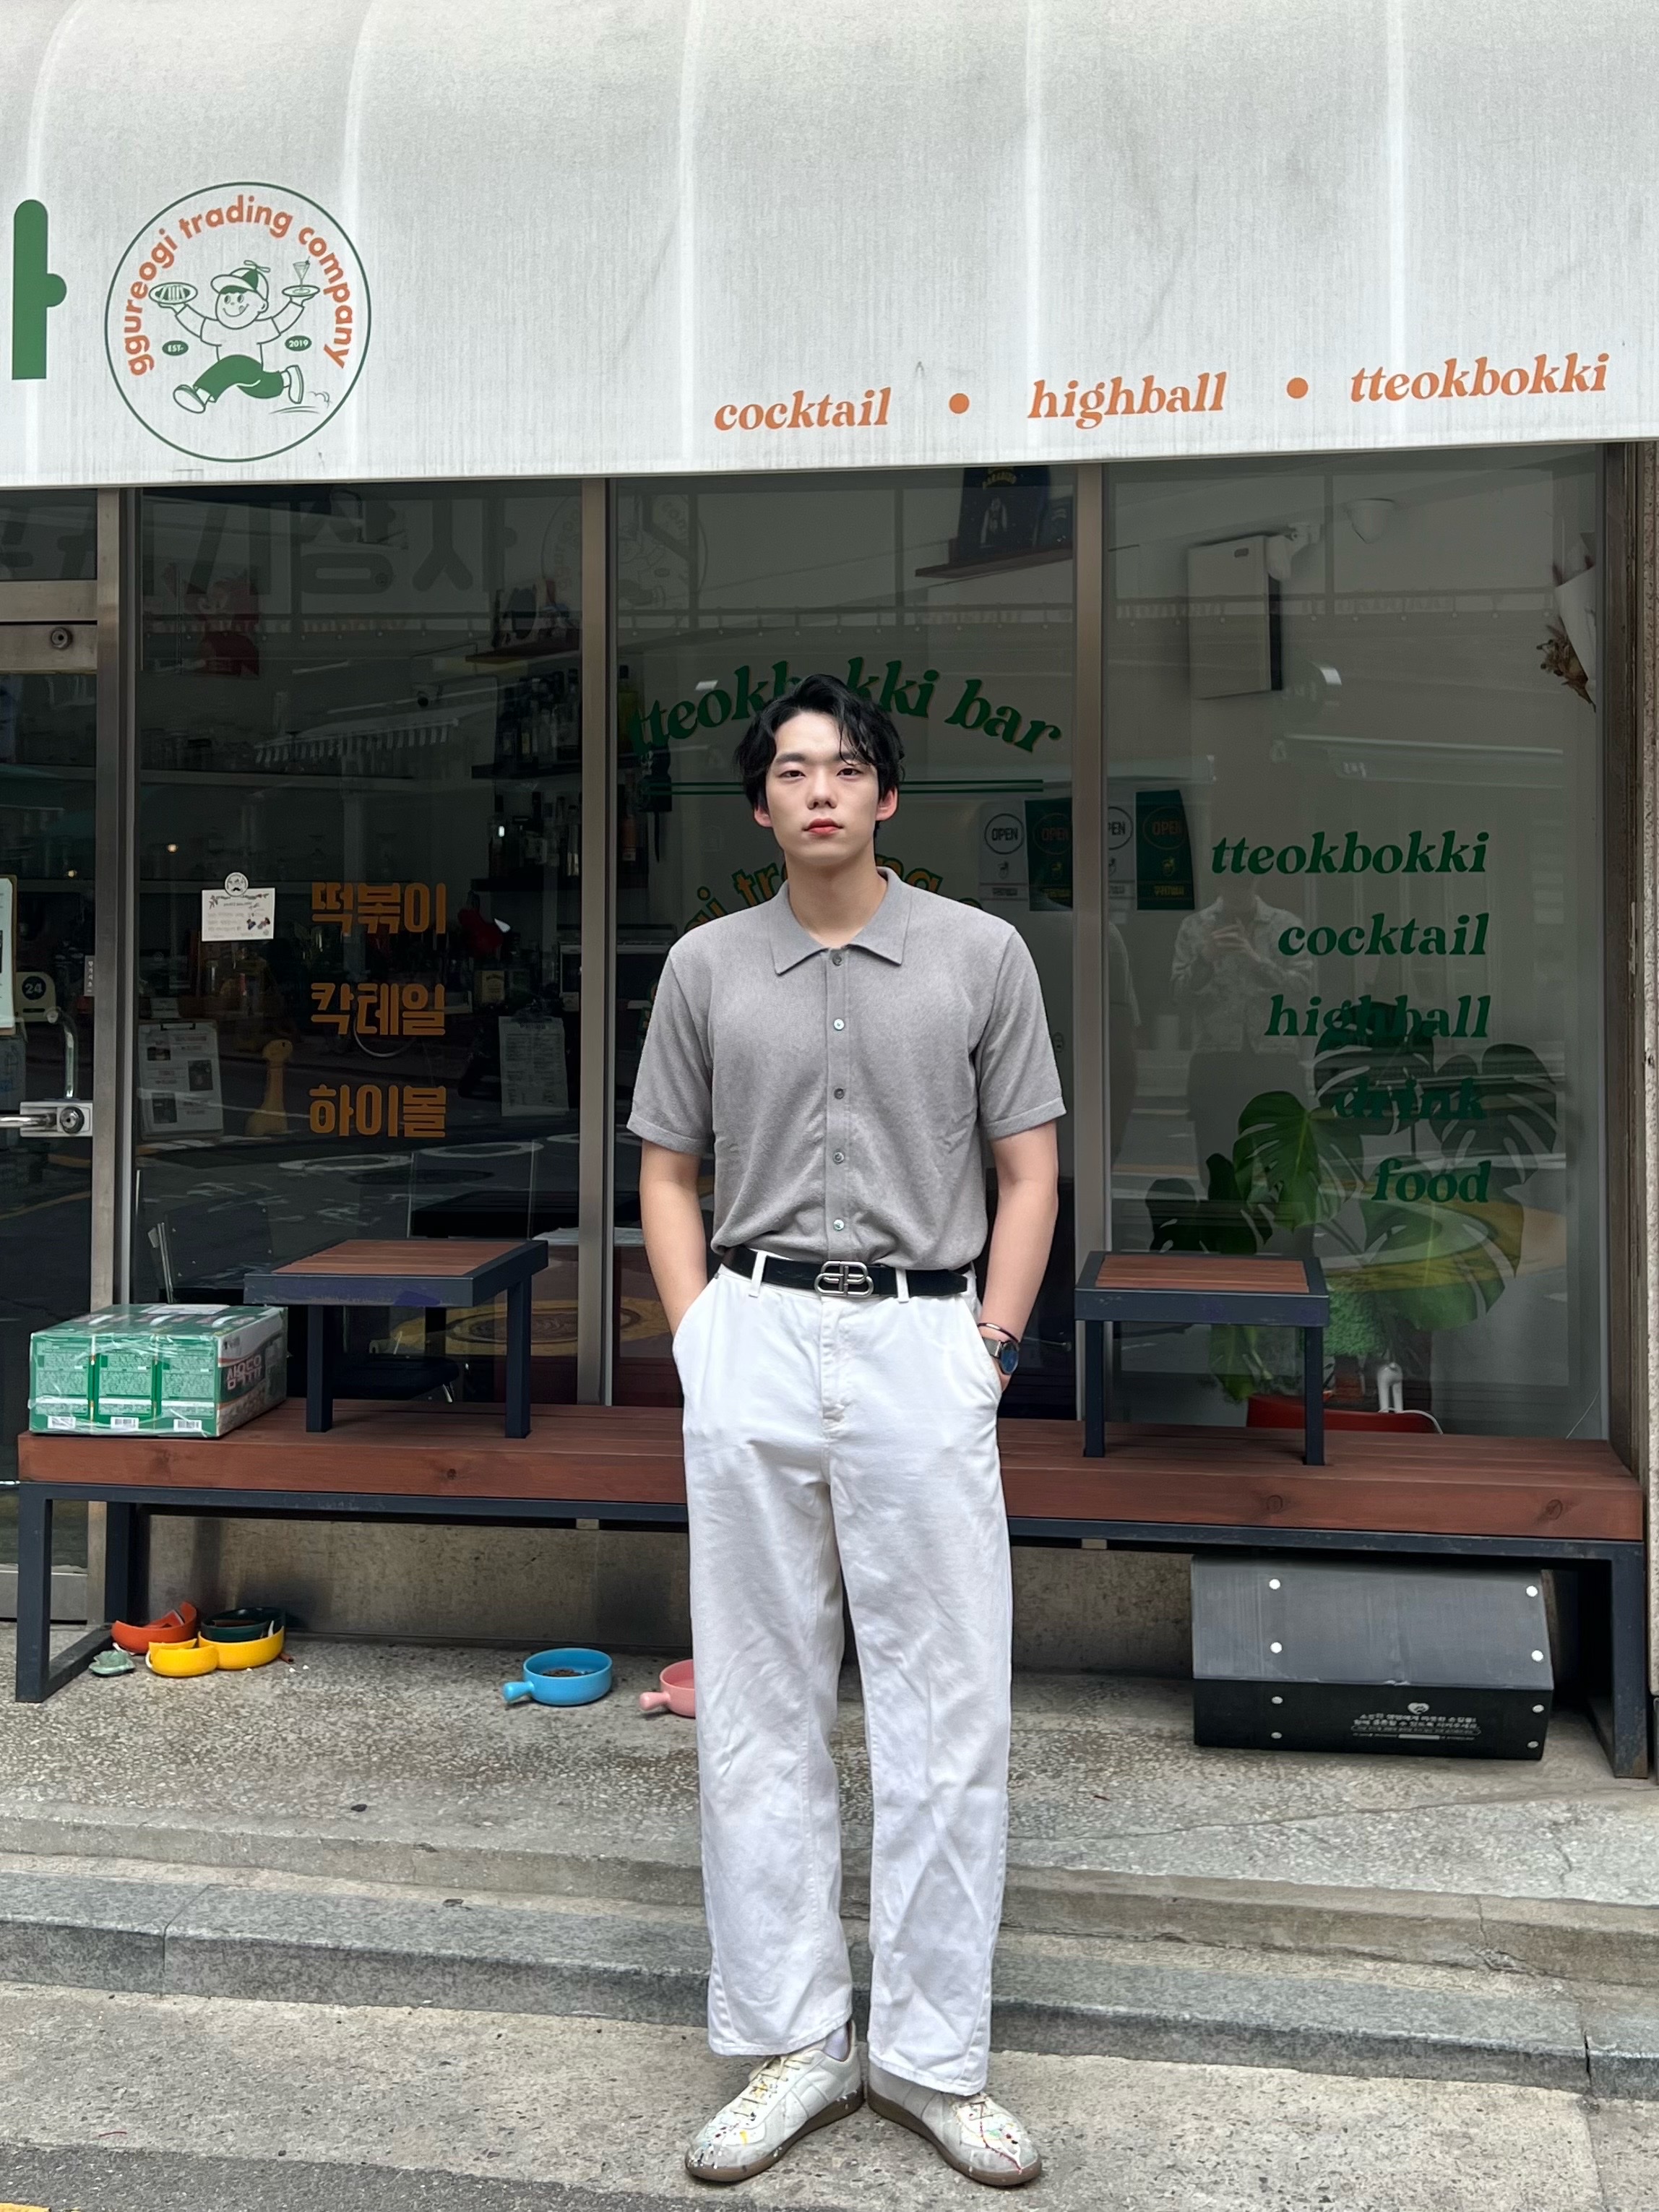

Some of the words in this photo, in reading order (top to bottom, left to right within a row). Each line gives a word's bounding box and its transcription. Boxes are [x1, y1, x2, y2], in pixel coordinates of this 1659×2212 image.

[124, 228, 178, 376] ggureogi
[178, 195, 293, 239] trading
[298, 226, 353, 369] company
[714, 387, 891, 431] cocktail
[1029, 372, 1226, 429] highball
[1351, 353, 1609, 403] tteokbokki
[944, 678, 1061, 752] bar
[991, 827, 1018, 841] OPEN
[1212, 831, 1490, 874] tteokbokki
[312, 882, 446, 934] 떡볶이
[1278, 913, 1490, 956] cocktail
[25, 983, 43, 994] 24
[311, 983, 446, 1036] 칵테일
[1264, 994, 1491, 1050] highball
[309, 1085, 446, 1137] 하이볼
[1332, 1075, 1487, 1120] drink
[1371, 1158, 1492, 1202] food
[226, 1354, 262, 1390] 삼육두유
